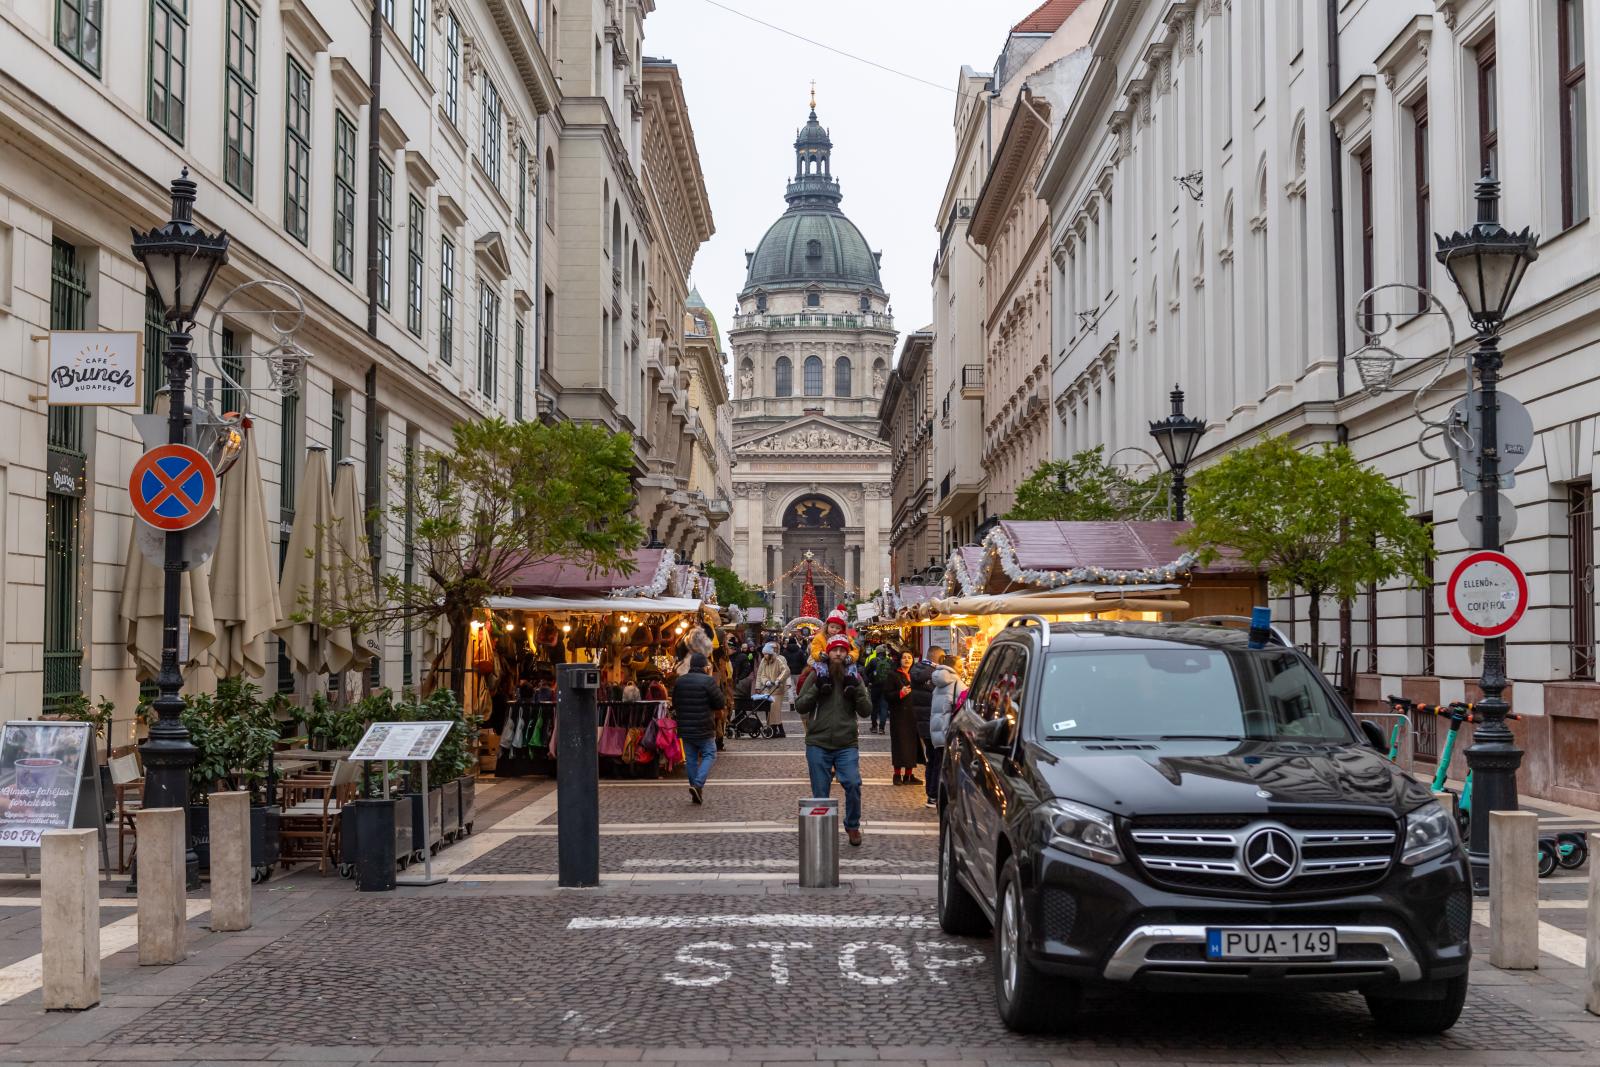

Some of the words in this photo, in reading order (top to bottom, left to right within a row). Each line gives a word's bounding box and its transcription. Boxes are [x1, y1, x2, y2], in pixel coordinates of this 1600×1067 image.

[51, 365, 135, 388] Brunch
[75, 384, 117, 392] BUDAPEST
[366, 639, 380, 650] Bru
[1211, 944, 1219, 953] H
[1226, 931, 1331, 954] PUA-149
[662, 941, 986, 987] STOP
